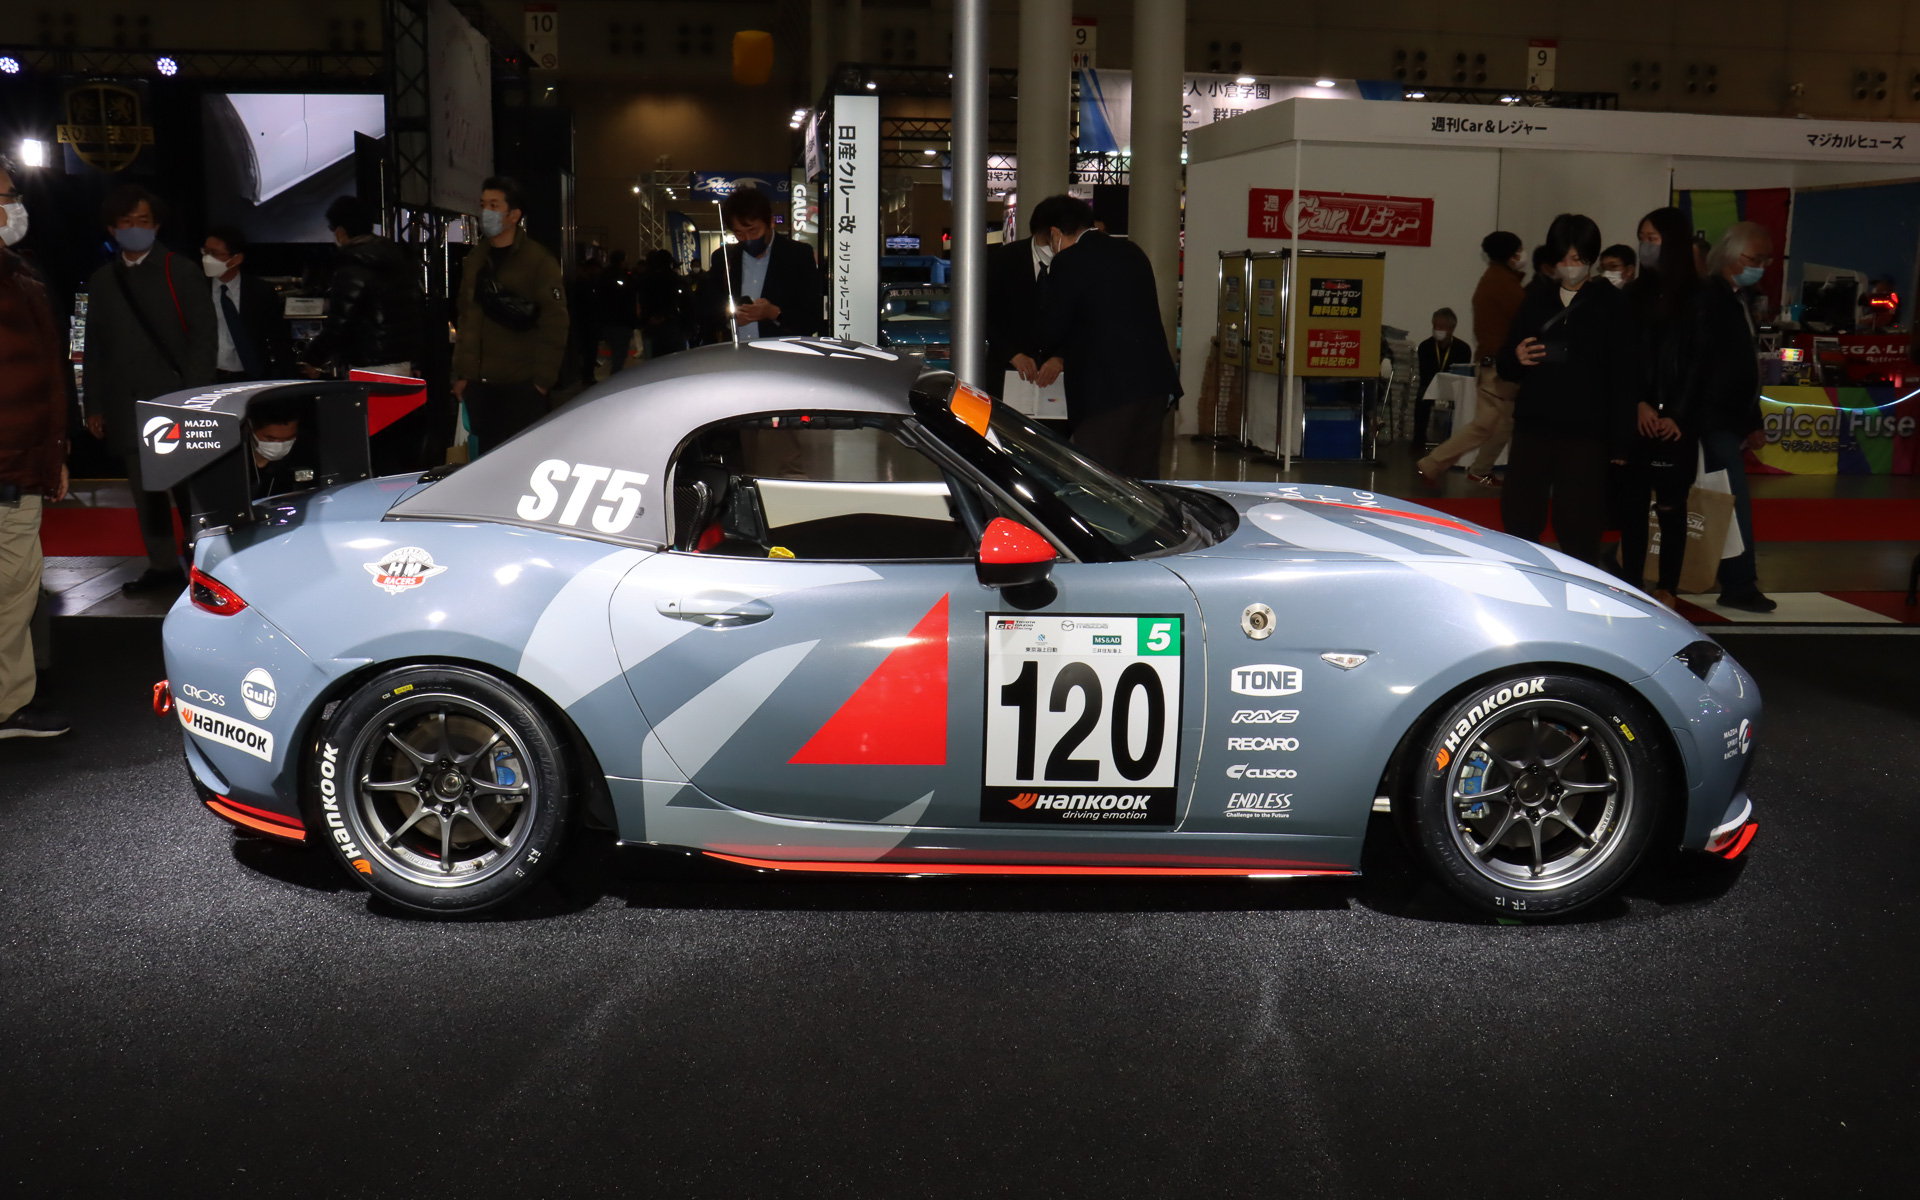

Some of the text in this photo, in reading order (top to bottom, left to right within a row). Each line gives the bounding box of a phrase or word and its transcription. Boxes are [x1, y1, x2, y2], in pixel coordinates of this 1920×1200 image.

[532, 15, 552, 32] 10
[1076, 28, 1087, 45] 9
[1537, 50, 1547, 66] 9
[1208, 81, 1270, 100] 小倉学園
[1431, 117, 1547, 135] 週刊Car&レジャー
[1806, 133, 1906, 149] マジカルヒューズ
[838, 125, 856, 234] 日産クルー改
[793, 184, 807, 231] GAUS
[1263, 194, 1280, 233] 週刊
[184, 420, 219, 428] MAZDA
[1849, 409, 1916, 437] Fuse
[185, 430, 213, 439] SPIRIT
[186, 441, 221, 450] RACING
[516, 459, 650, 534] ST5
[384, 577, 416, 585] RACERS
[1146, 623, 1172, 652] 5
[1237, 671, 1297, 690] TONE
[182, 683, 226, 707] CROSS
[242, 682, 276, 706] Gulf
[1000, 660, 1166, 782] 120
[1231, 710, 1300, 724] RAYS
[1723, 727, 1738, 740] MAZDA
[1227, 737, 1300, 751] RECARO
[1726, 737, 1739, 749] SPIRIT
[1723, 747, 1739, 761] RACING
[1227, 792, 1294, 809] ENDLESS
[1062, 810, 1148, 821] driving emotion
